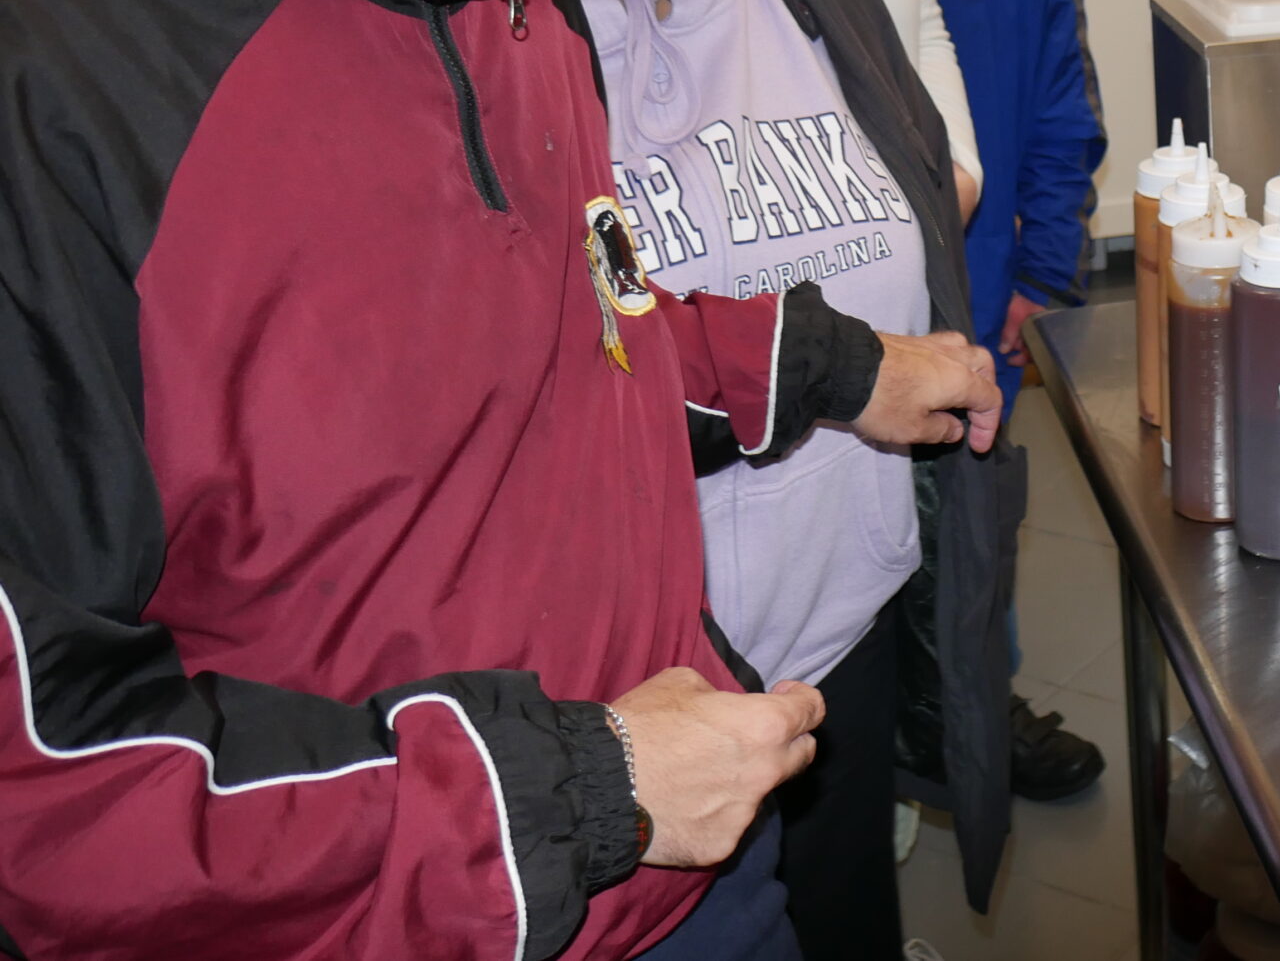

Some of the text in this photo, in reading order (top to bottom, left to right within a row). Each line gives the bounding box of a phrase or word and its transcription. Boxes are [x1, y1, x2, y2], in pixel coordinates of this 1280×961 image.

[610, 111, 912, 274] ER BANKS
[733, 232, 892, 301] CAROLINA
